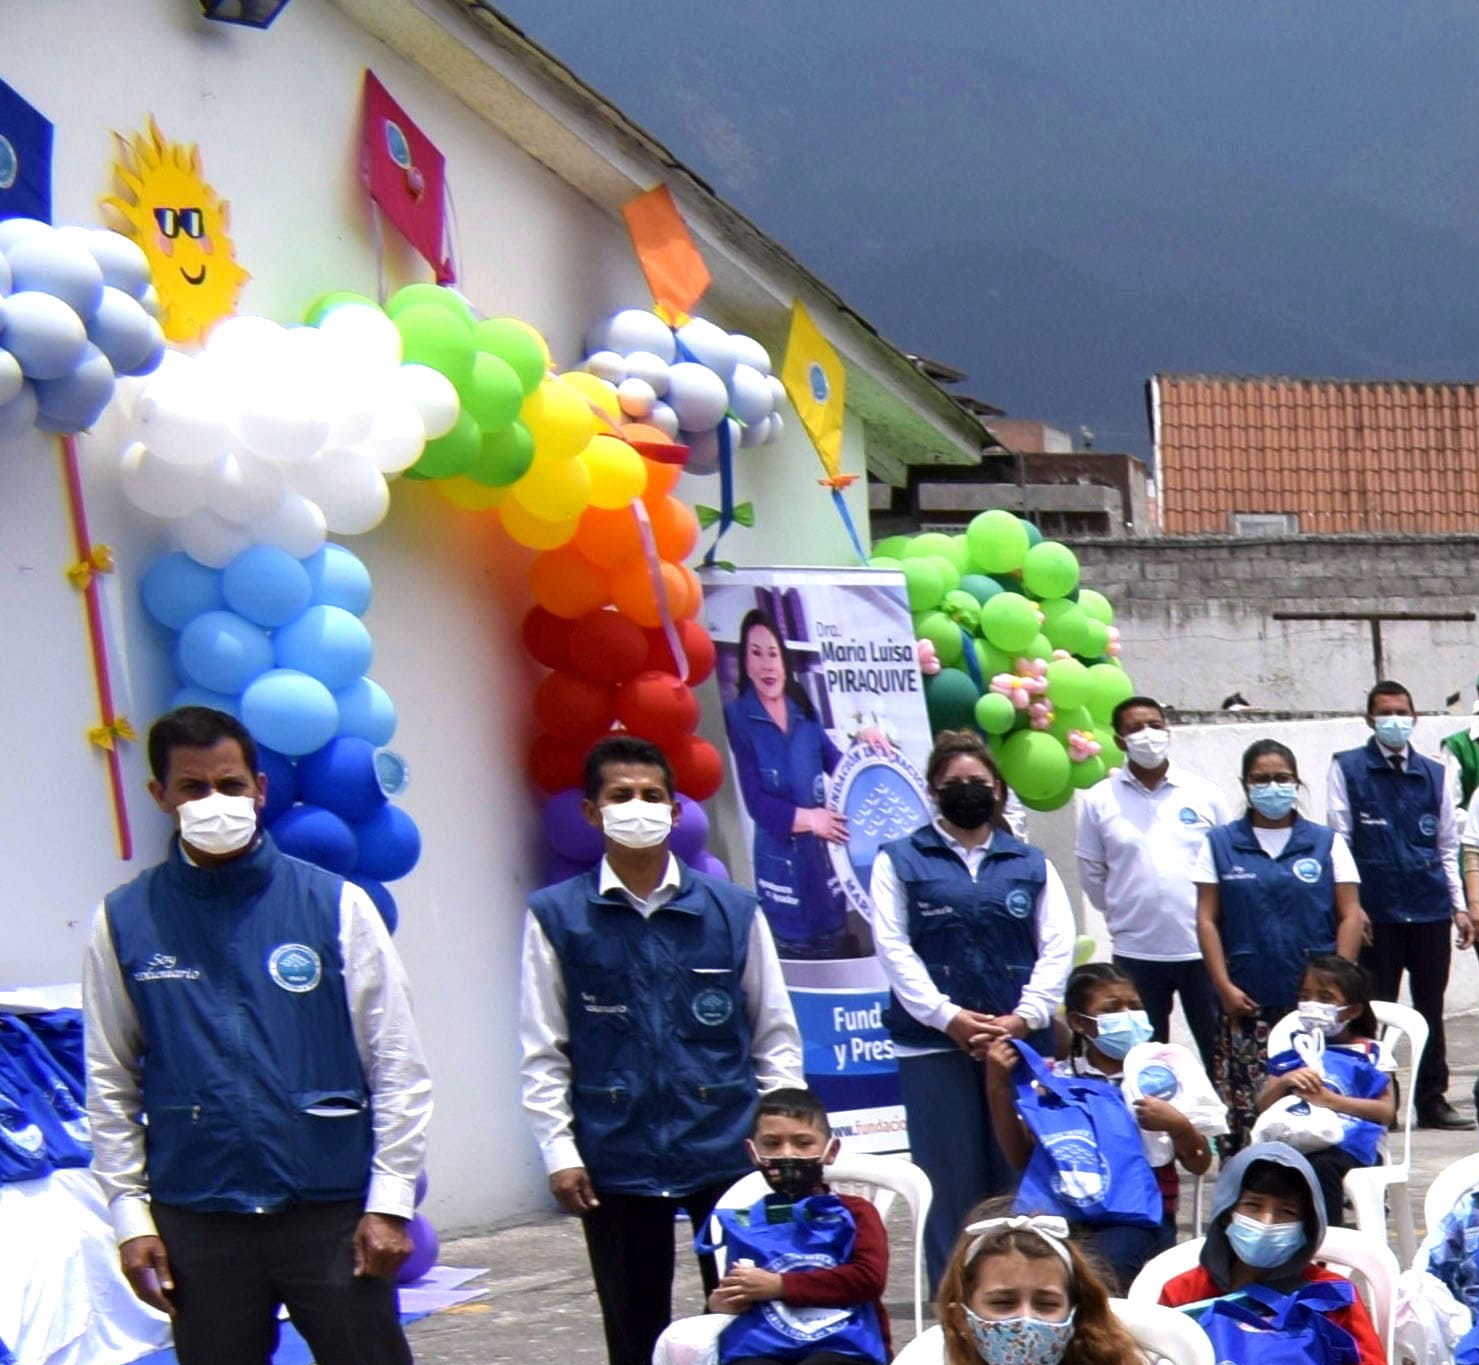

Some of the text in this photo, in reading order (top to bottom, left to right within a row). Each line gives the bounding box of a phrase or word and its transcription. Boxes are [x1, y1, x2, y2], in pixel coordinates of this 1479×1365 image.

[871, 637, 913, 662] Luisa
[826, 668, 918, 695] PIRAQUIVE
[833, 1002, 882, 1032] Fund
[833, 1037, 895, 1071] y Pres
